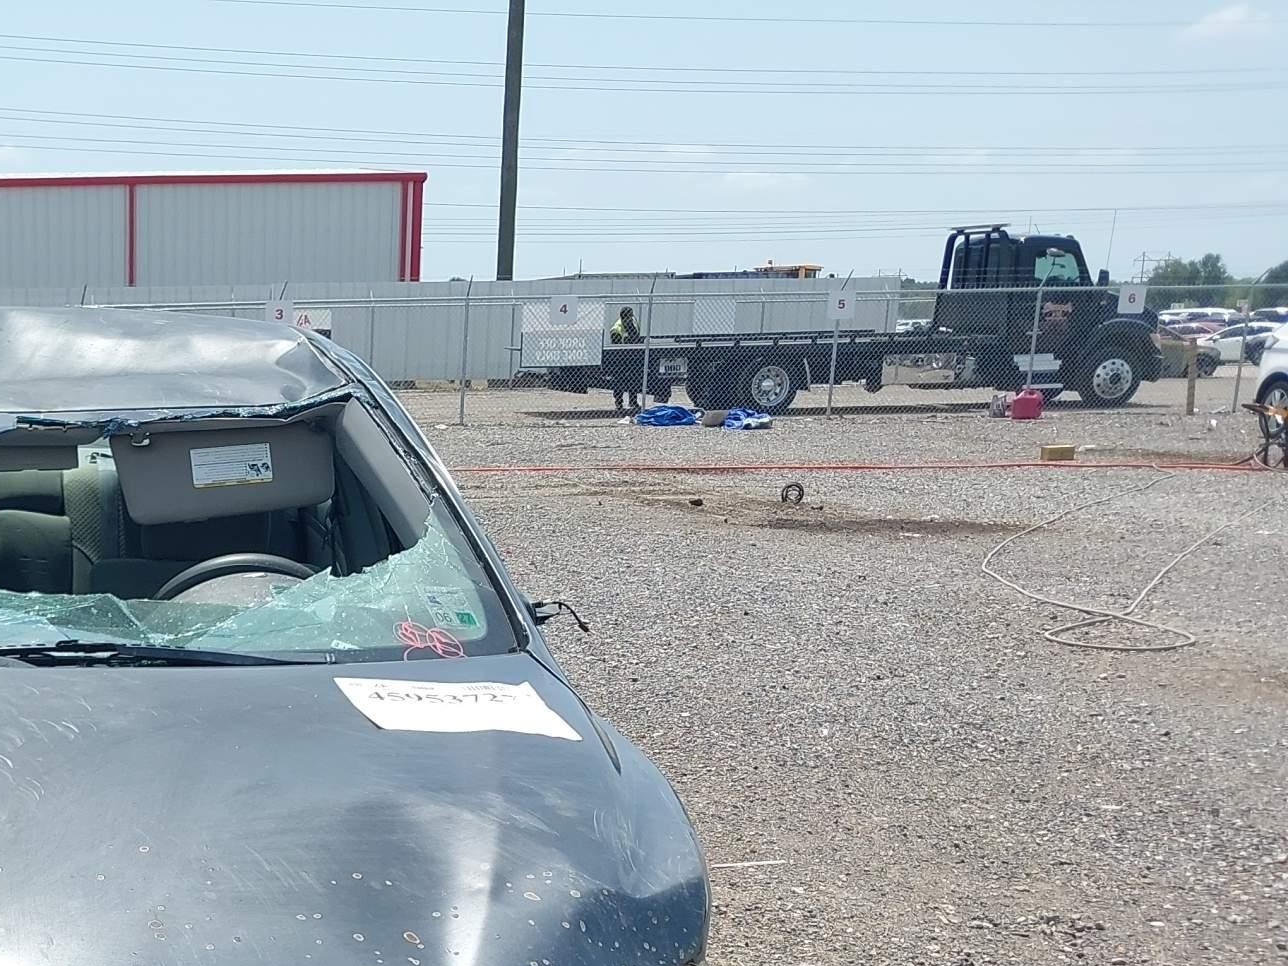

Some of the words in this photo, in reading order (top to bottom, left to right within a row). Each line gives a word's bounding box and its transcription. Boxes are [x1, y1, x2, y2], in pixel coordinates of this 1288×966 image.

[1128, 293, 1137, 304] 6
[559, 304, 569, 315] 4
[837, 299, 846, 310] 5
[275, 309, 285, 320] 3
[435, 612, 452, 623] 06
